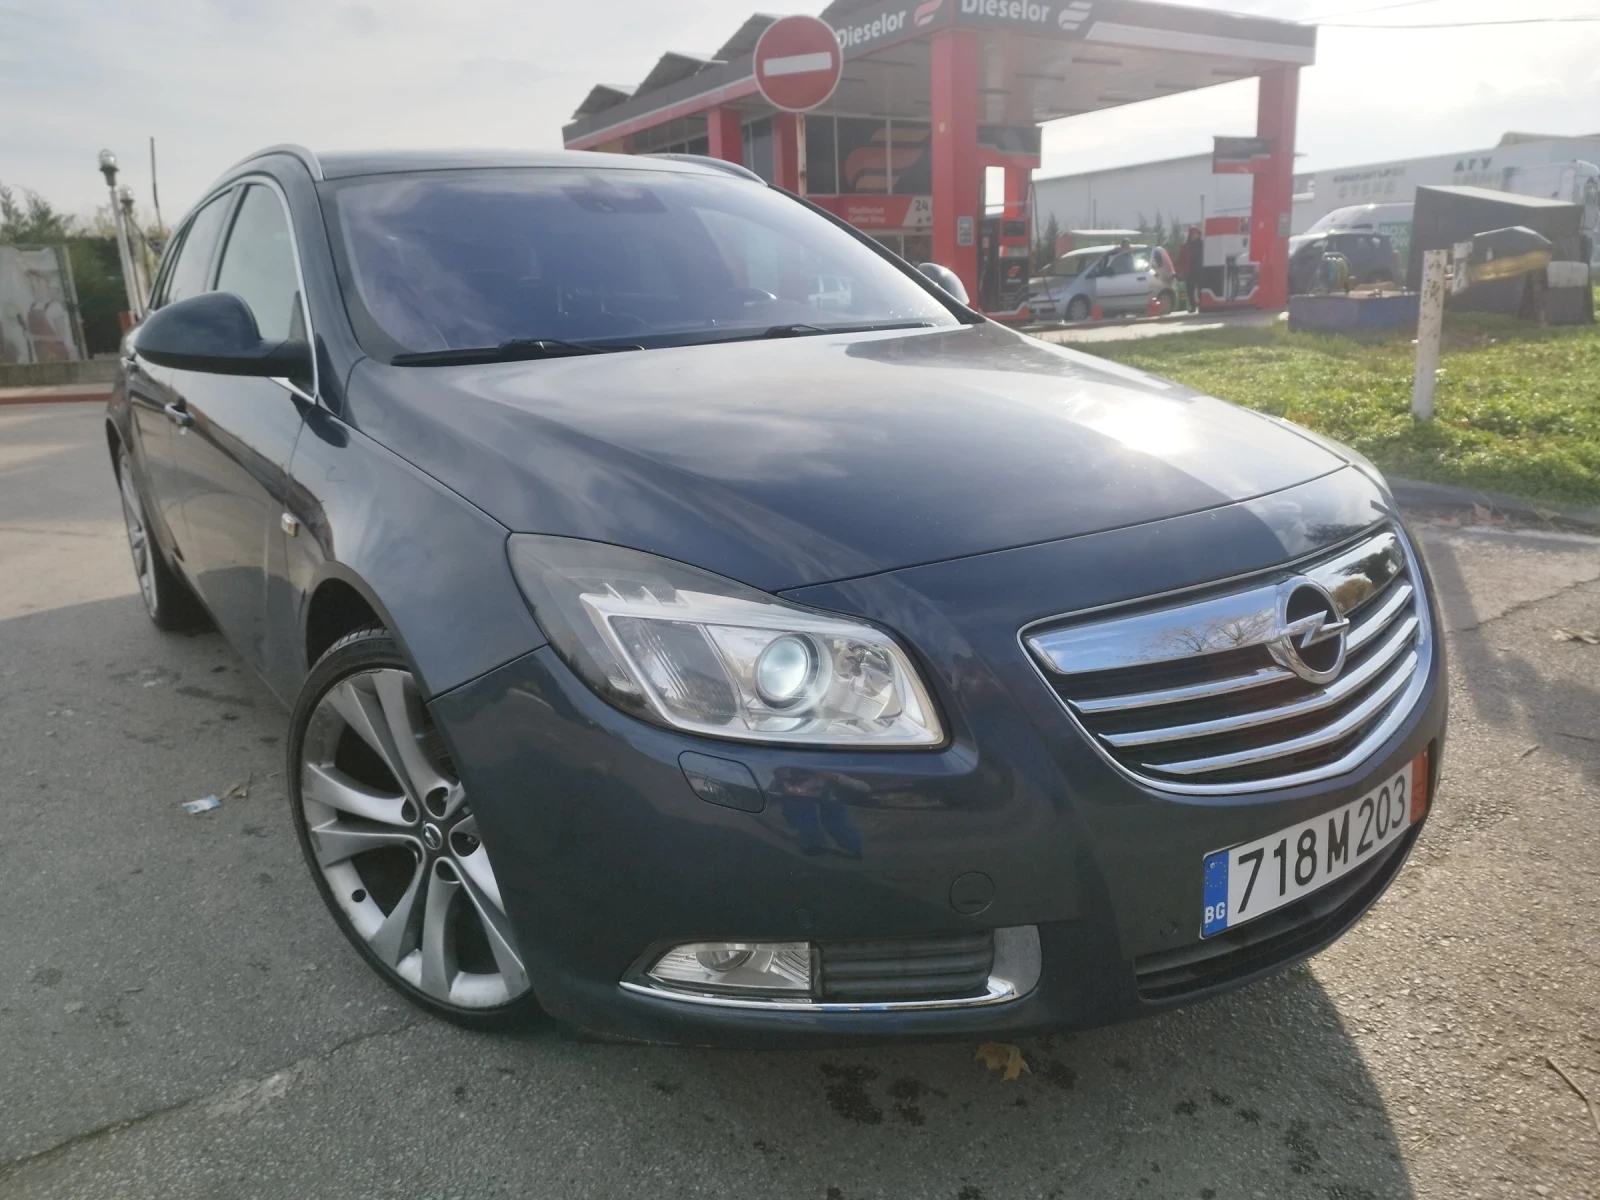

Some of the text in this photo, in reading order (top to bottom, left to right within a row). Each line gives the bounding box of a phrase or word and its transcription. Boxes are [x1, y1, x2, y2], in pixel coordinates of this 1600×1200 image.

[961, 0, 1050, 23] Dieselor
[836, 10, 906, 49] Dieselor
[1204, 901, 1226, 924] BG
